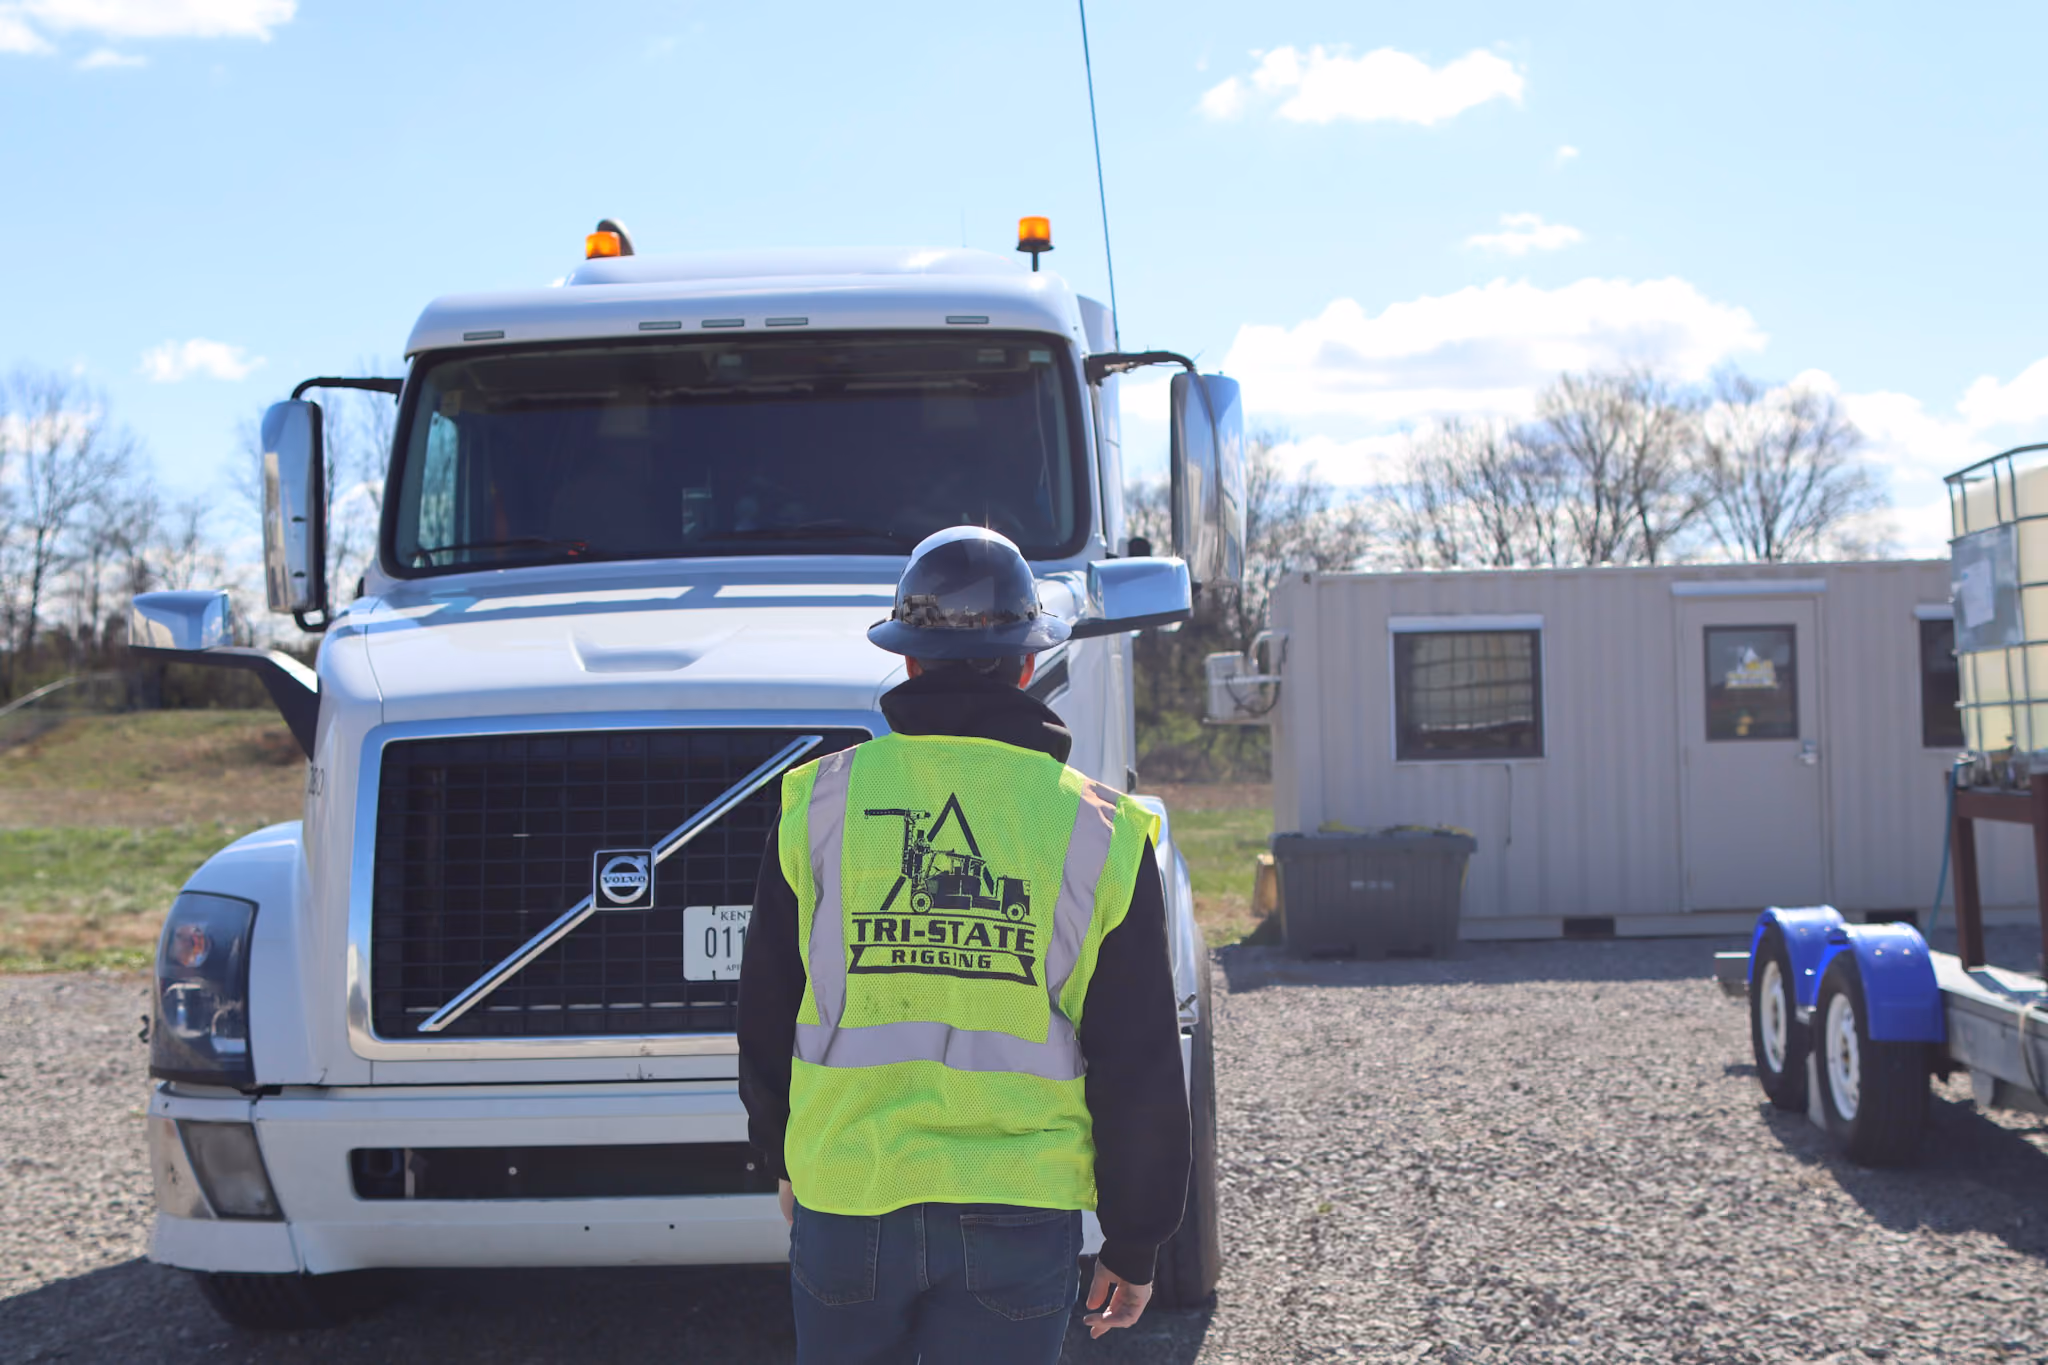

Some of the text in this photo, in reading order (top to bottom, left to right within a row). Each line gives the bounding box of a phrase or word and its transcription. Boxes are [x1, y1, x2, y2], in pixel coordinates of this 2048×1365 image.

[603, 876, 646, 884] VOLVO
[852, 918, 1035, 953] TRI-STATE
[891, 949, 992, 969] RIGGING
